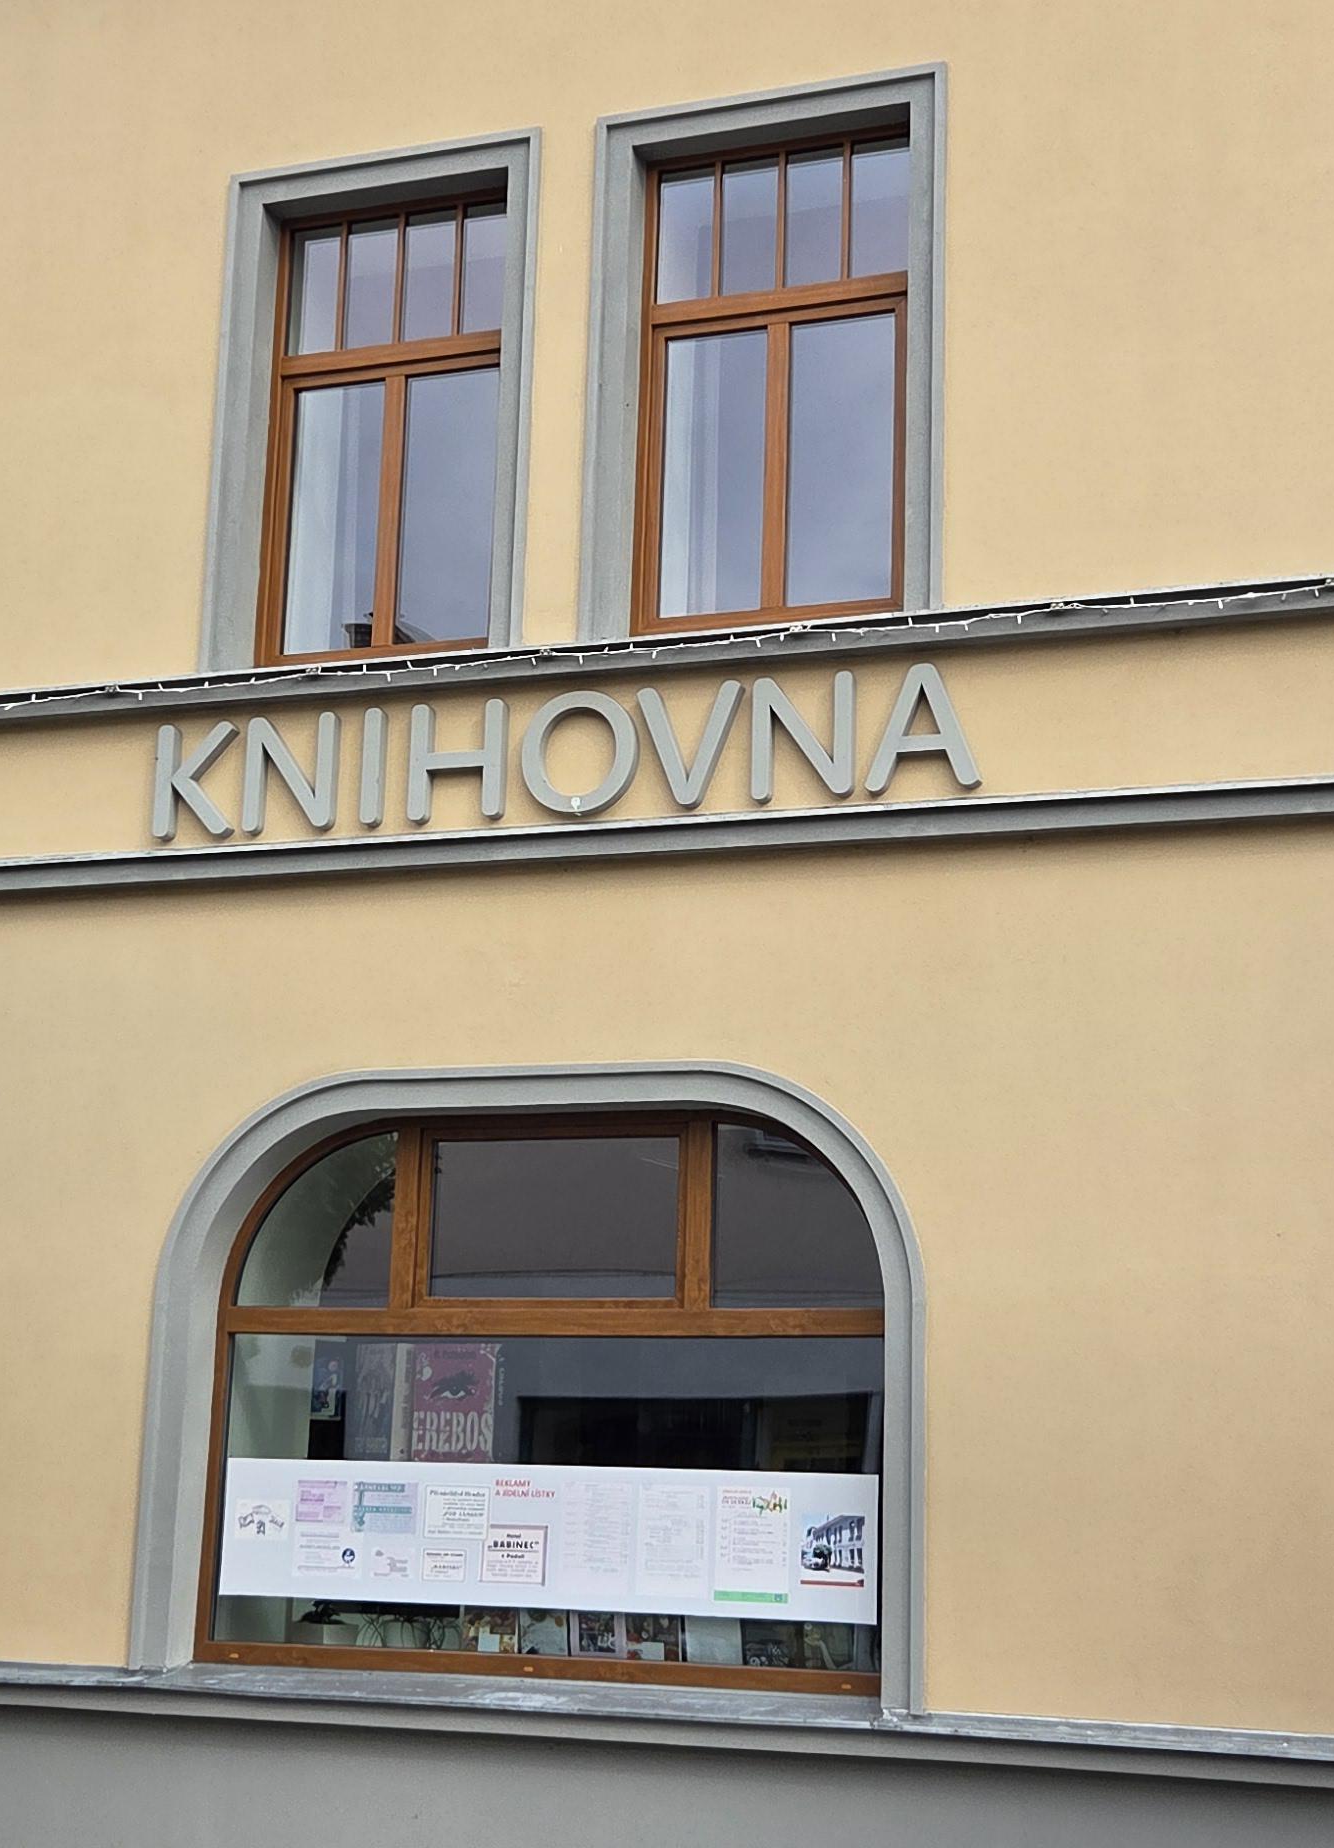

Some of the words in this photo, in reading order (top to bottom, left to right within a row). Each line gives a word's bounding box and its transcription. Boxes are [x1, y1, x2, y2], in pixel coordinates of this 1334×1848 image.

[151, 661, 983, 842] KNIHOVNA
[412, 1410, 494, 1452] EREBOS
[495, 1479, 531, 1487] REKLAMY
[502, 1487, 529, 1497] JÍDELNÍ
[531, 1488, 555, 1498] LÍSTKY
